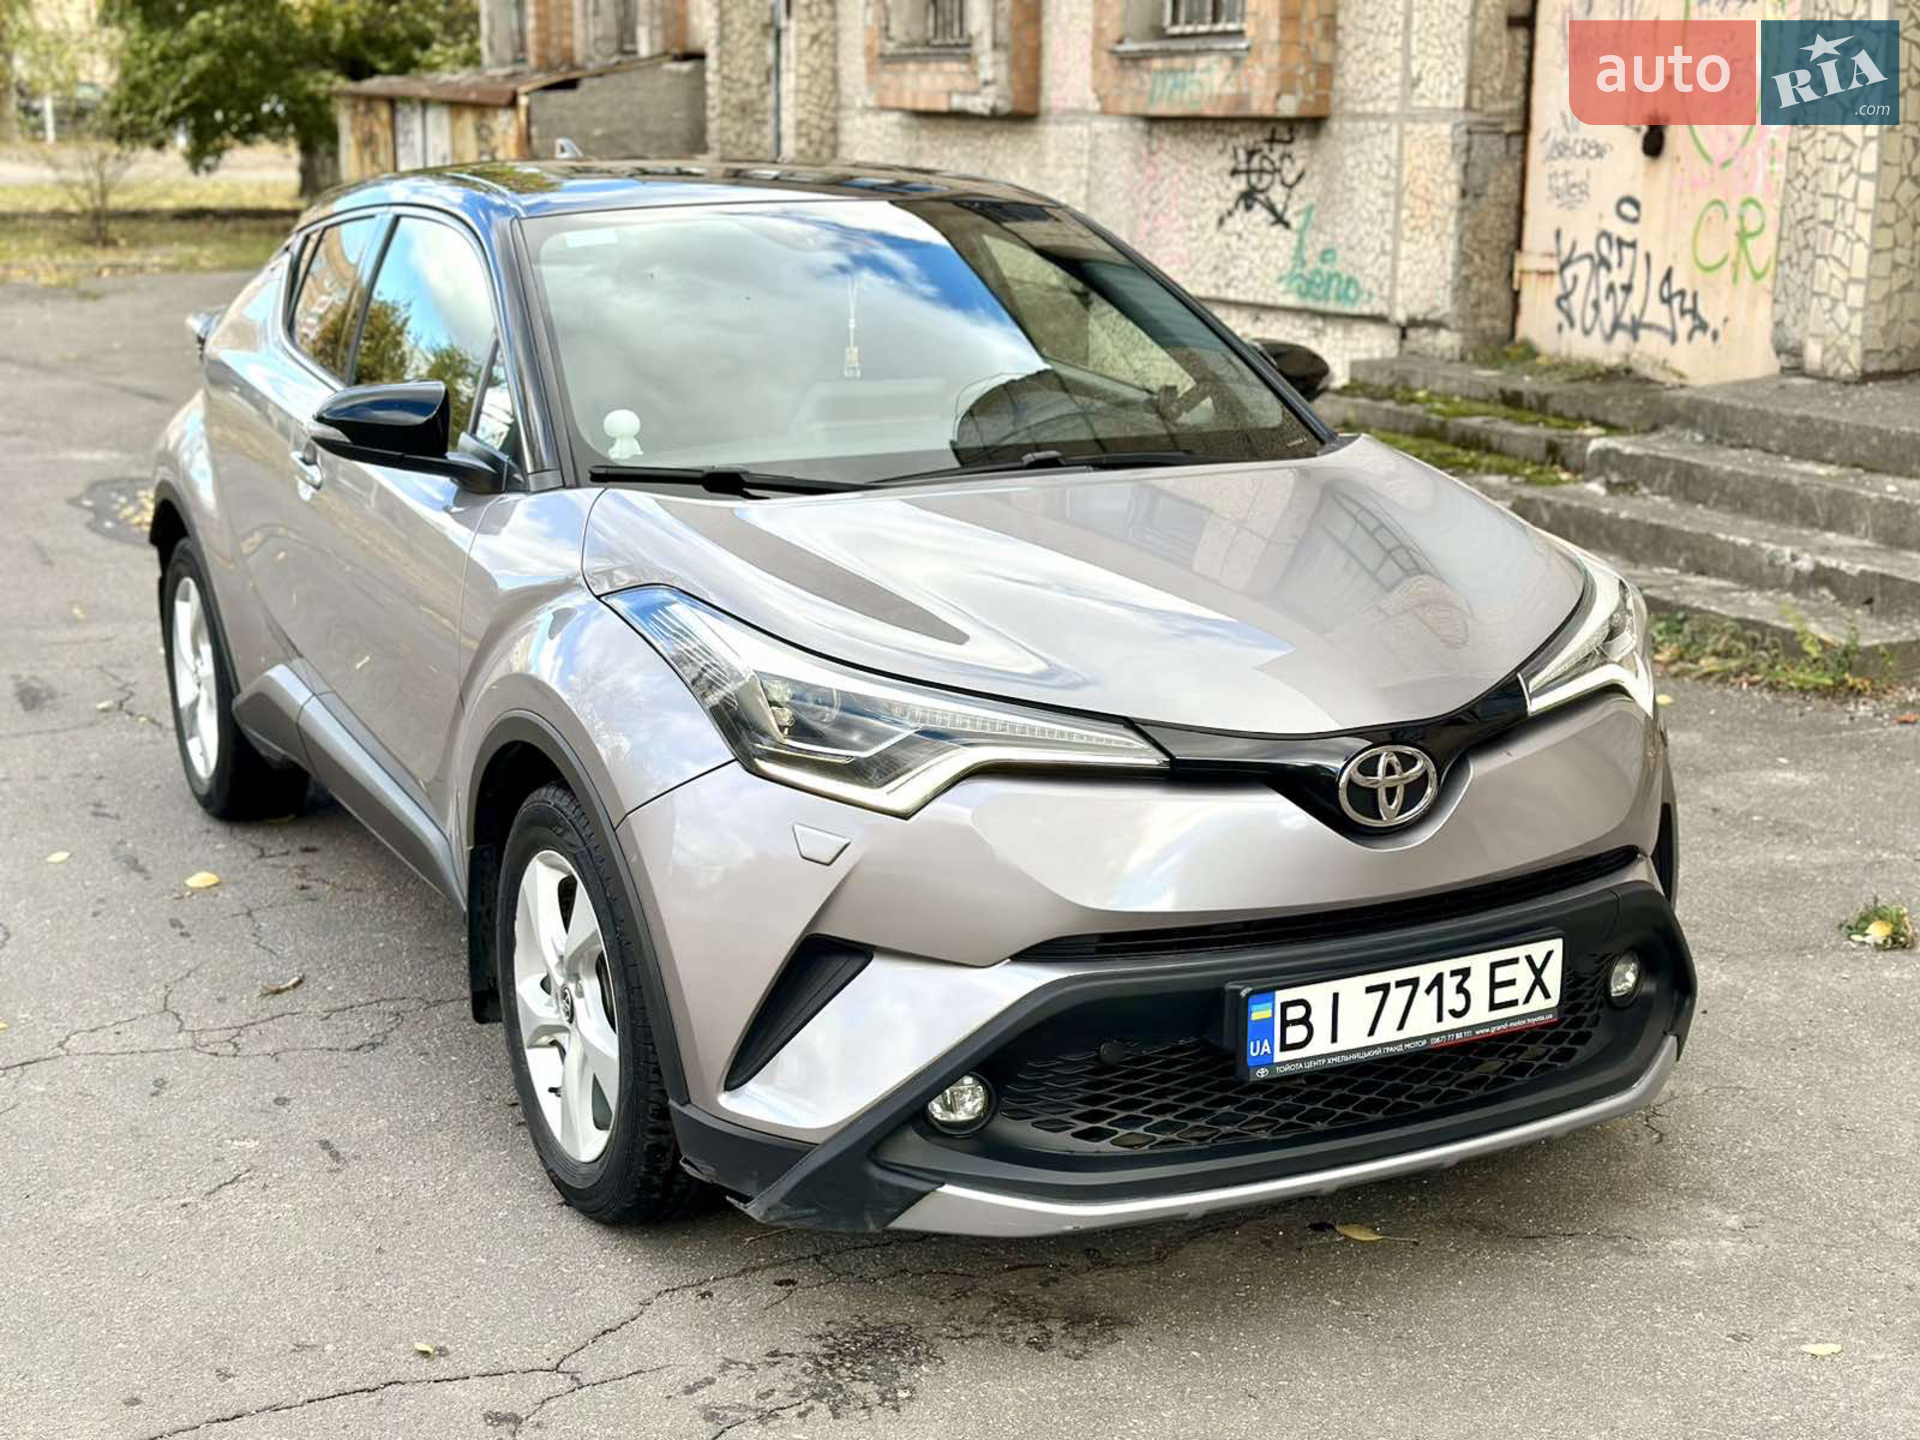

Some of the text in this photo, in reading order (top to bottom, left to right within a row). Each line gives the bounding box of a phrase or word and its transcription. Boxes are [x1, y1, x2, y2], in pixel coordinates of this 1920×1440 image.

[1365, 966, 1471, 1037] 7713
[1489, 950, 1554, 1012] EX
[1250, 1039, 1272, 1056] UA
[1276, 1039, 1427, 1074] ТОЙОТА ЦЕНТР ХМЕЛЬНИЦЬКИЙ ГРАНД МОТОР
